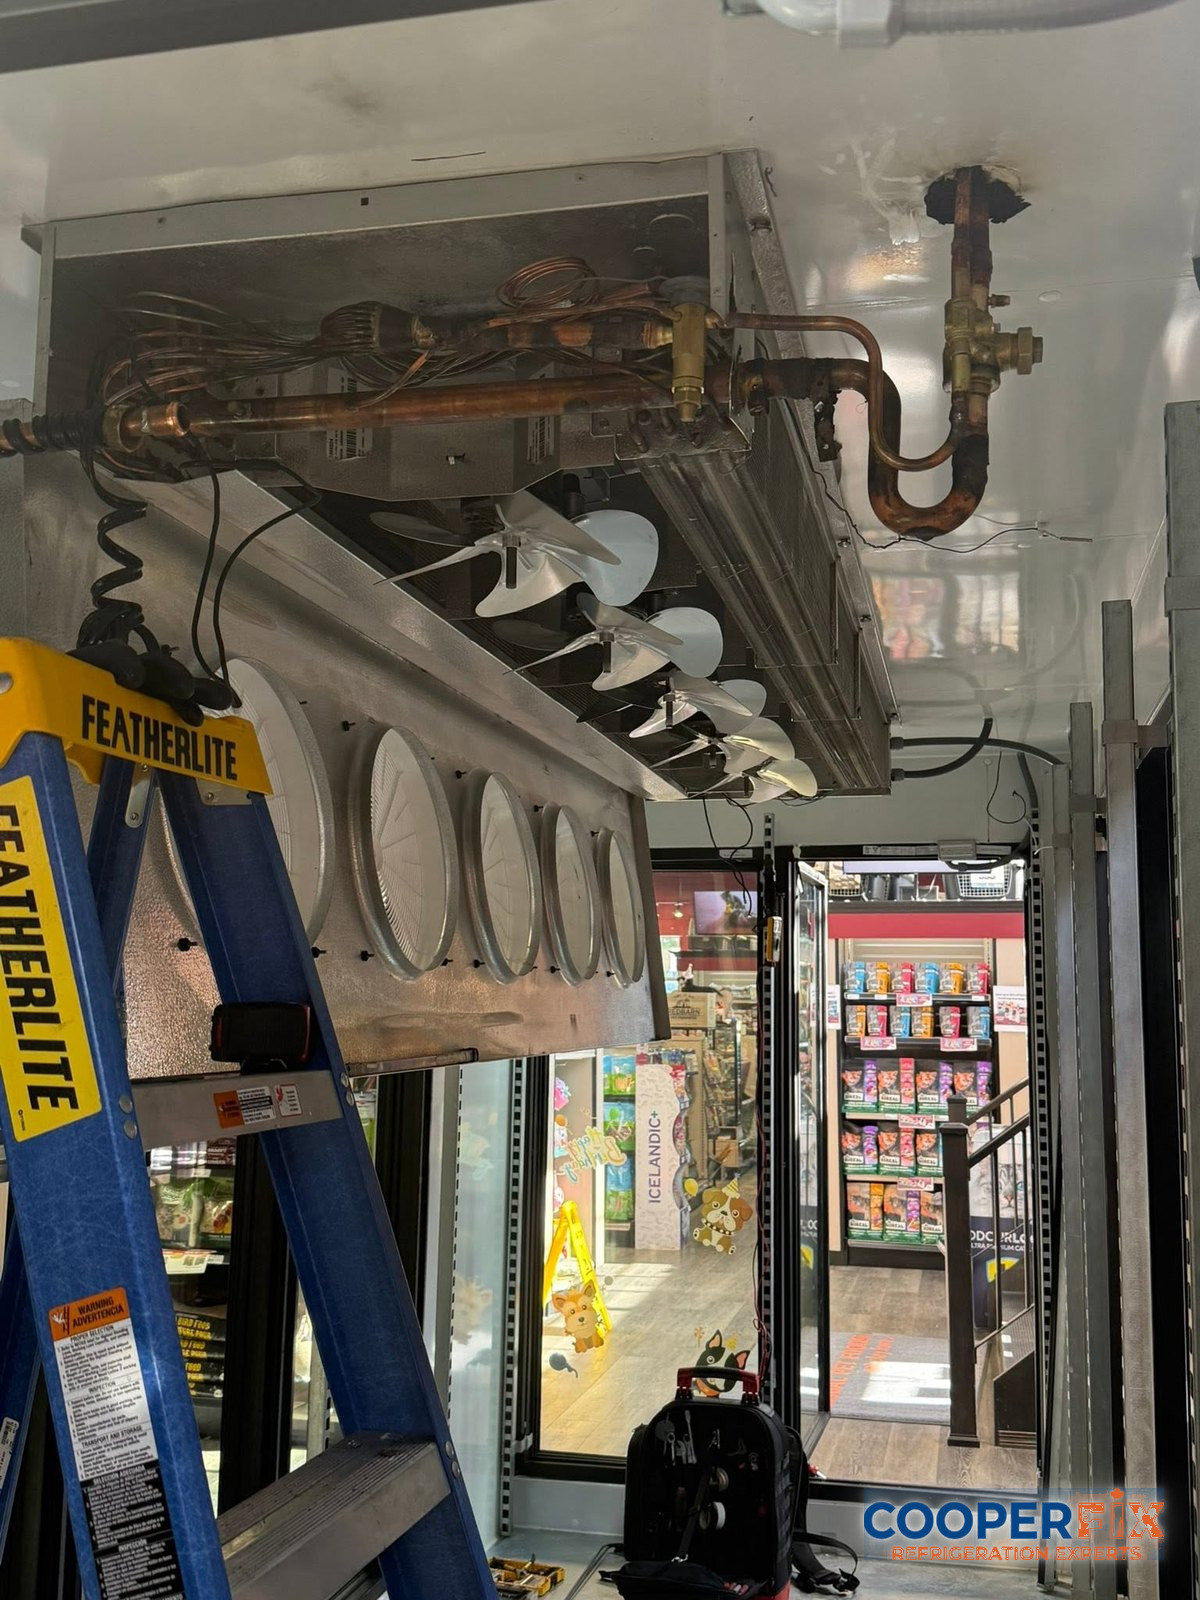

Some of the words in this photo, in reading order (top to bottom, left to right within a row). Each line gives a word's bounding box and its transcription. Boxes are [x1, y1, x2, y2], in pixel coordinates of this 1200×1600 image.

[81, 694, 239, 781] FEATHERLITE
[648, 1110, 661, 1203] ICELANDIC+
[73, 1303, 124, 1328] ADVERTENCIA
[78, 1296, 114, 1315] WARNING
